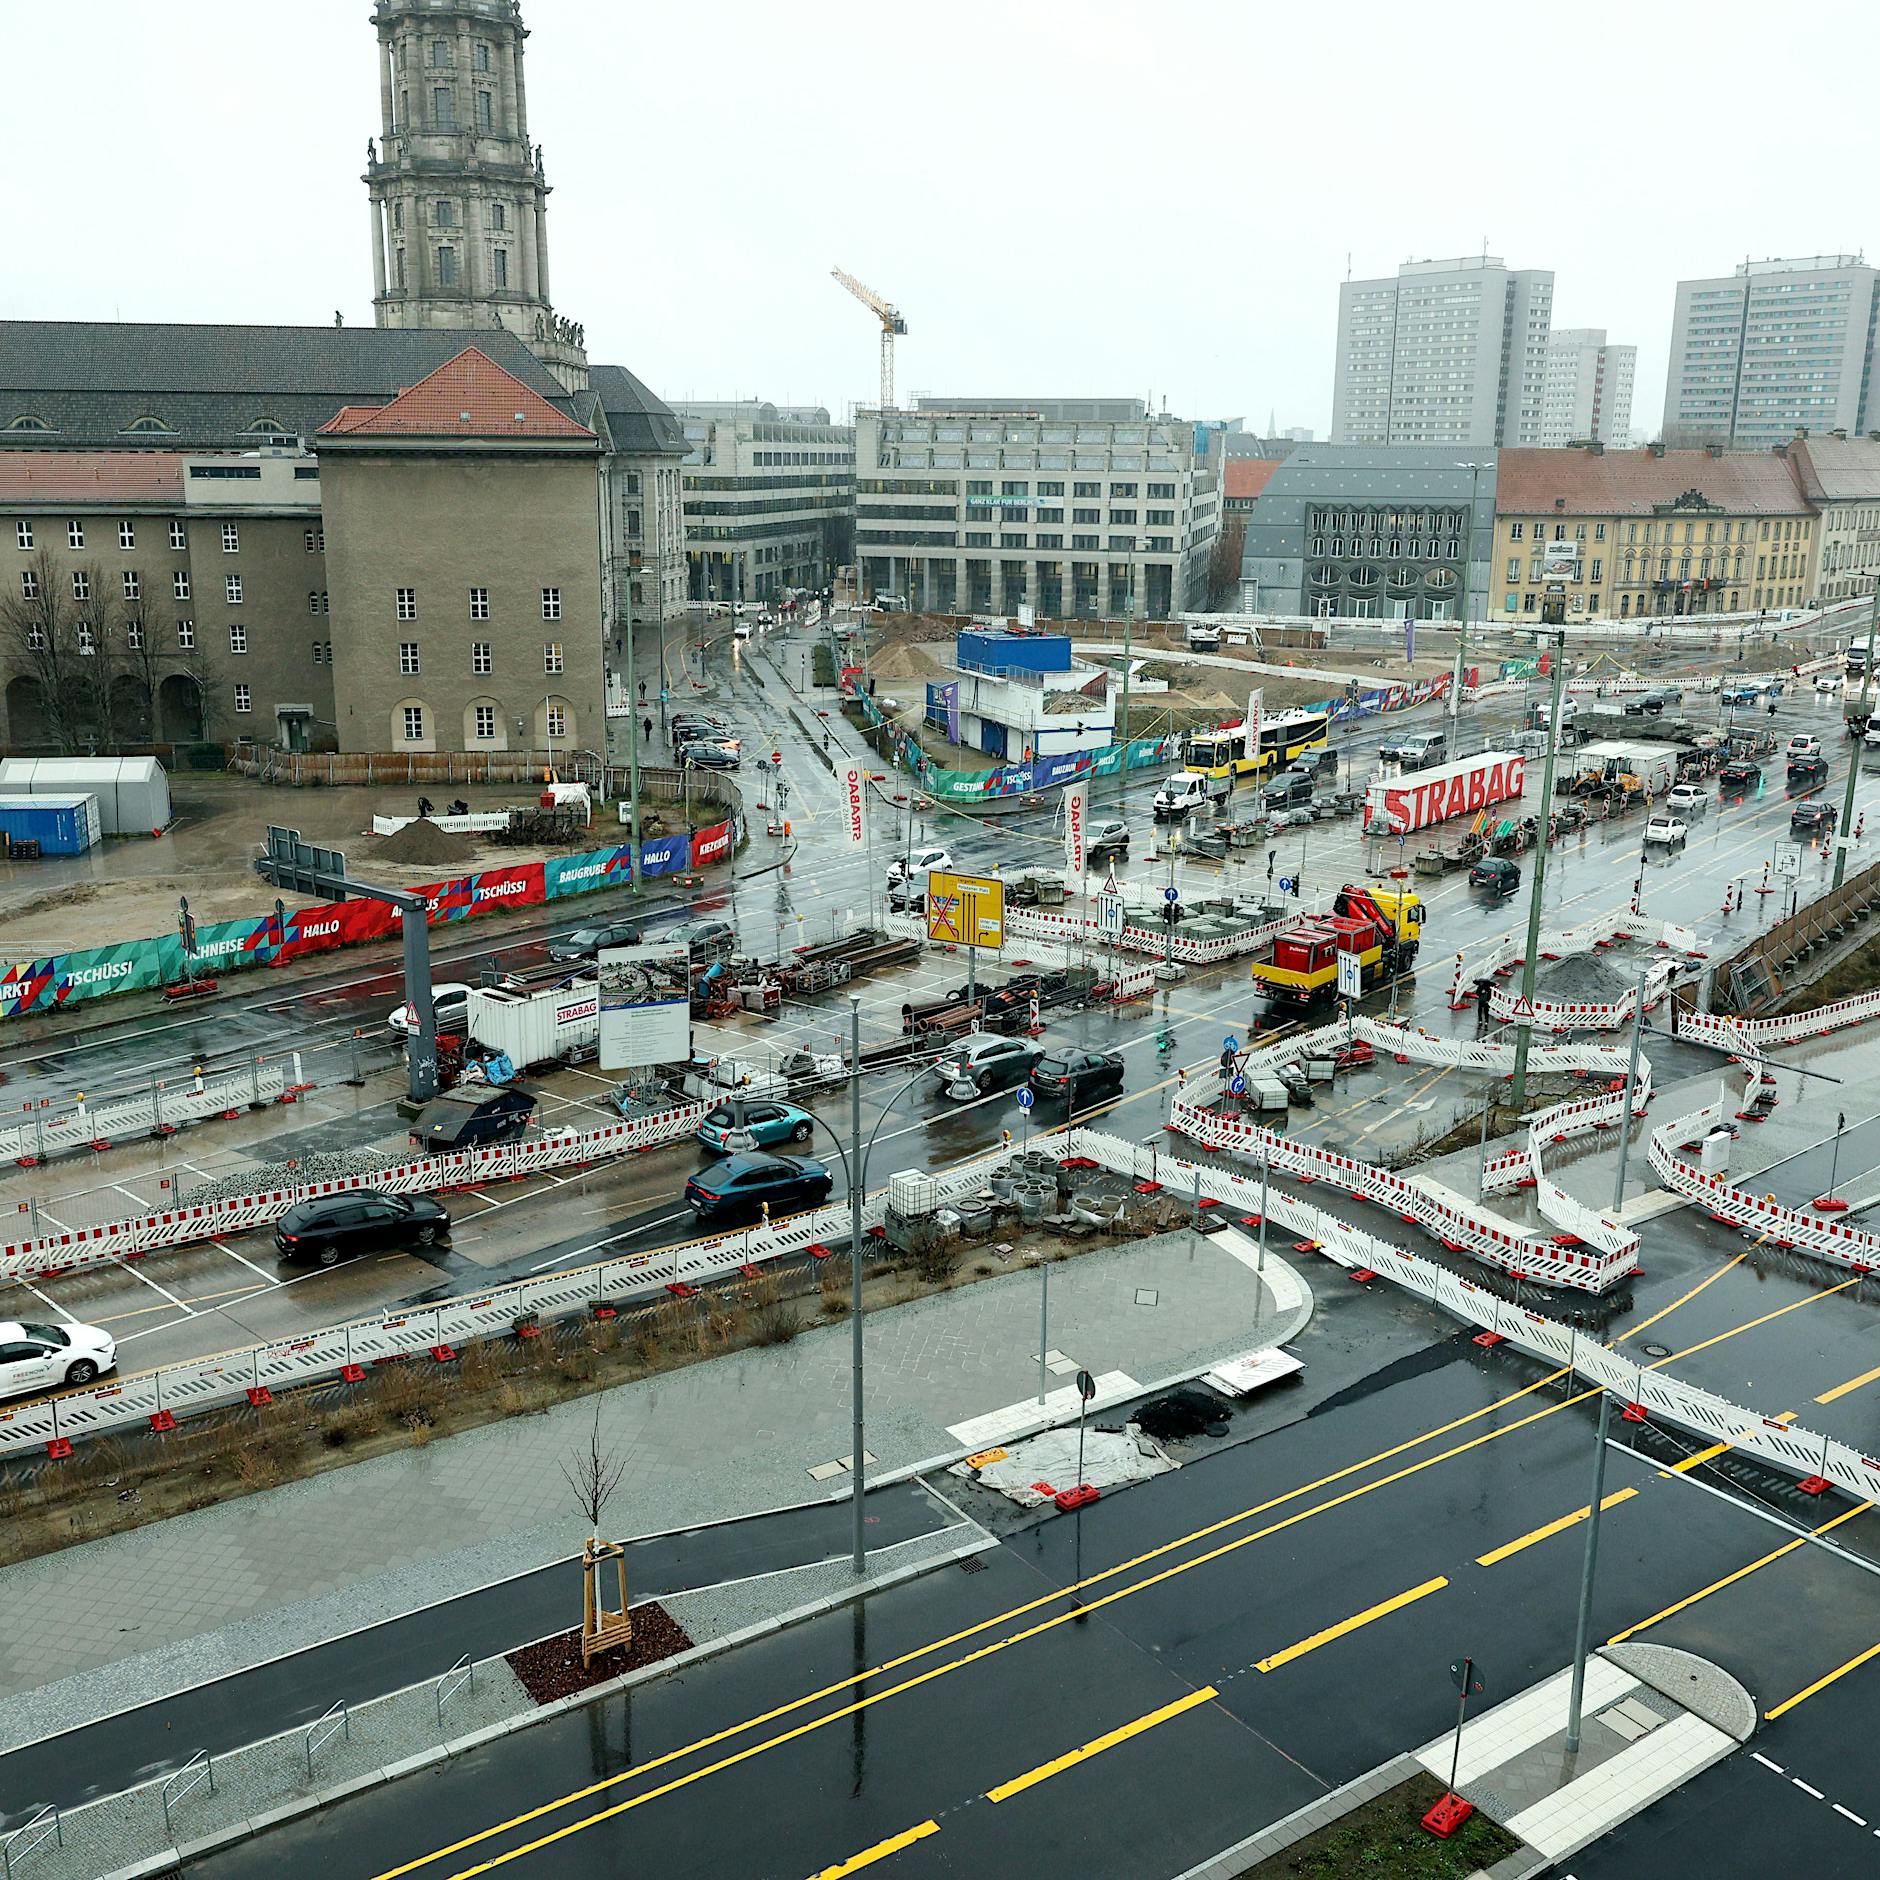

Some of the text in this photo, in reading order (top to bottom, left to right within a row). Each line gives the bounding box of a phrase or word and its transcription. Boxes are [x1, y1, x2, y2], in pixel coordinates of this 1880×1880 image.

[953, 780, 985, 792] GESTANK
[1006, 771, 1032, 785] TSCÜSS
[1385, 757, 1525, 835] STRABAG
[643, 850, 671, 866] HALLO
[559, 862, 607, 883] BAUGRUBE
[479, 880, 526, 901] TSCHÜSSI
[303, 920, 340, 938] HALLO
[66, 961, 133, 987] TSCHÜSSI
[557, 1003, 597, 1021] STRABAG
